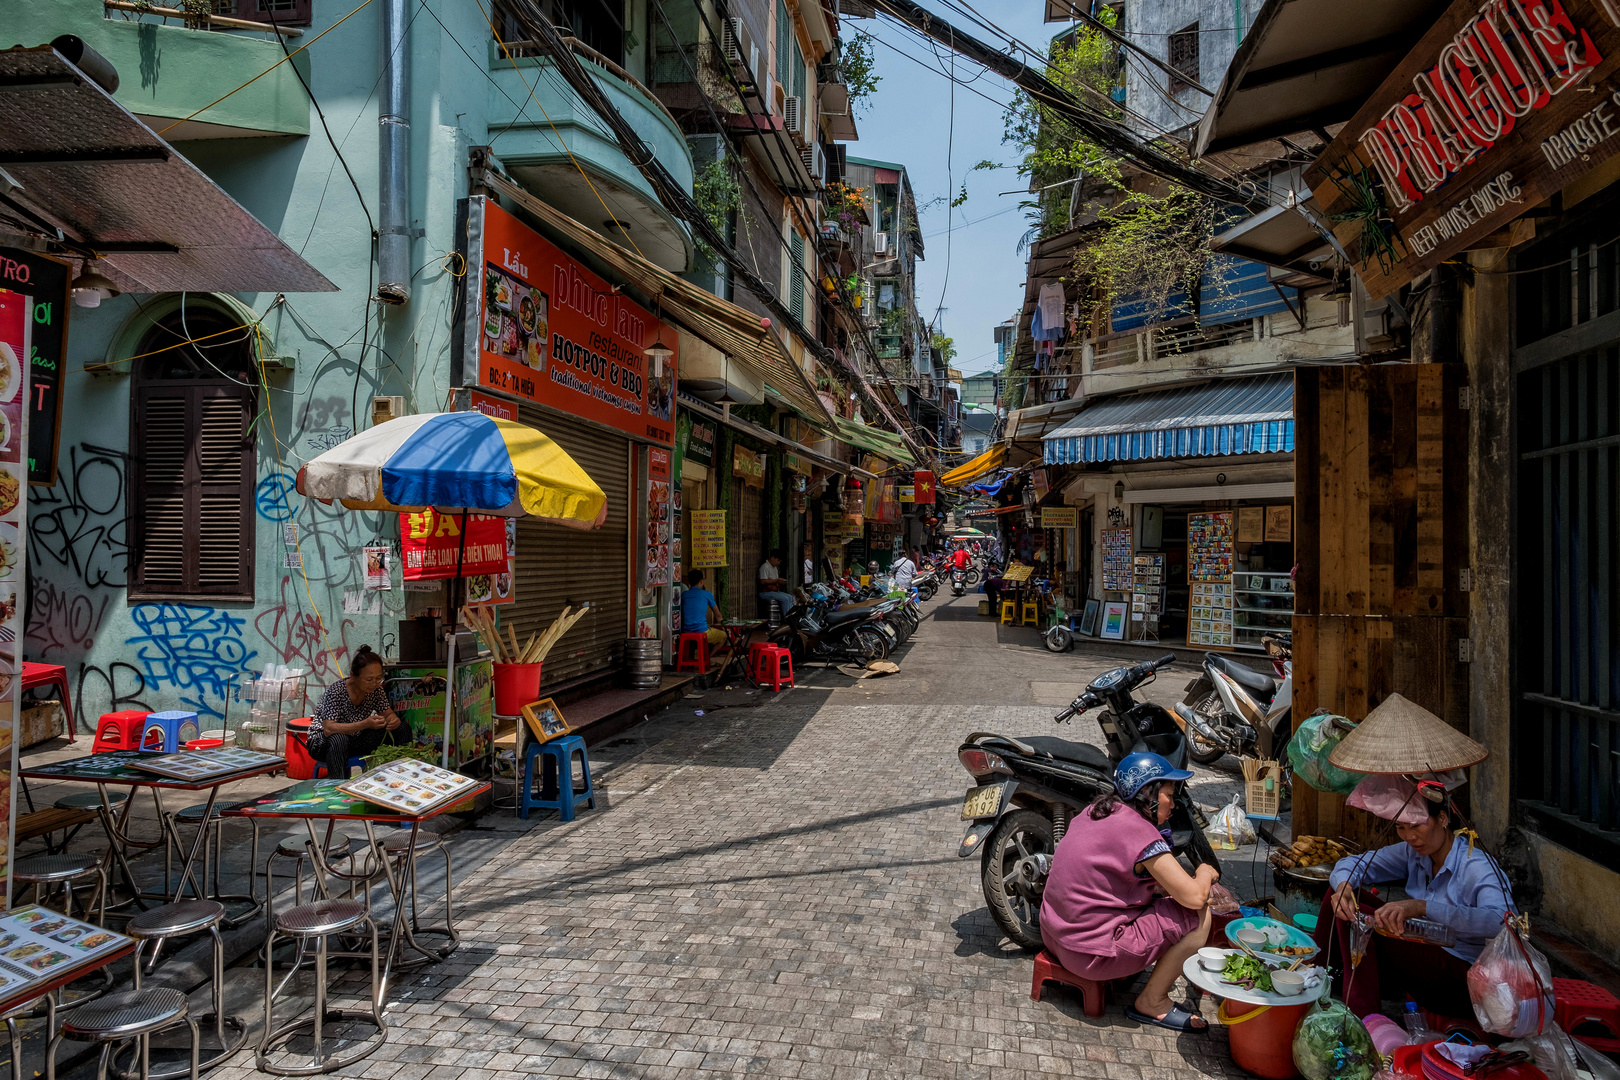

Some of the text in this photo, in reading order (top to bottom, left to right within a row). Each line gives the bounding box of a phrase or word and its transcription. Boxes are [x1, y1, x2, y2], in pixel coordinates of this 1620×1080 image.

[1358, 0, 1602, 213] PRAGUE
[1433, 198, 1481, 242] HOUSE
[503, 248, 528, 279] Lẩu
[552, 332, 643, 401] HOTPOT & BBQ
[589, 331, 643, 371] restaurant
[511, 374, 520, 396] TẠ
[551, 364, 592, 396] traditional
[407, 547, 422, 568] BÁN
[422, 546, 437, 567] CÁC
[467, 542, 483, 566] ĐIỆN
[483, 543, 503, 564] THOẠI
[966, 801, 994, 817] 3192
